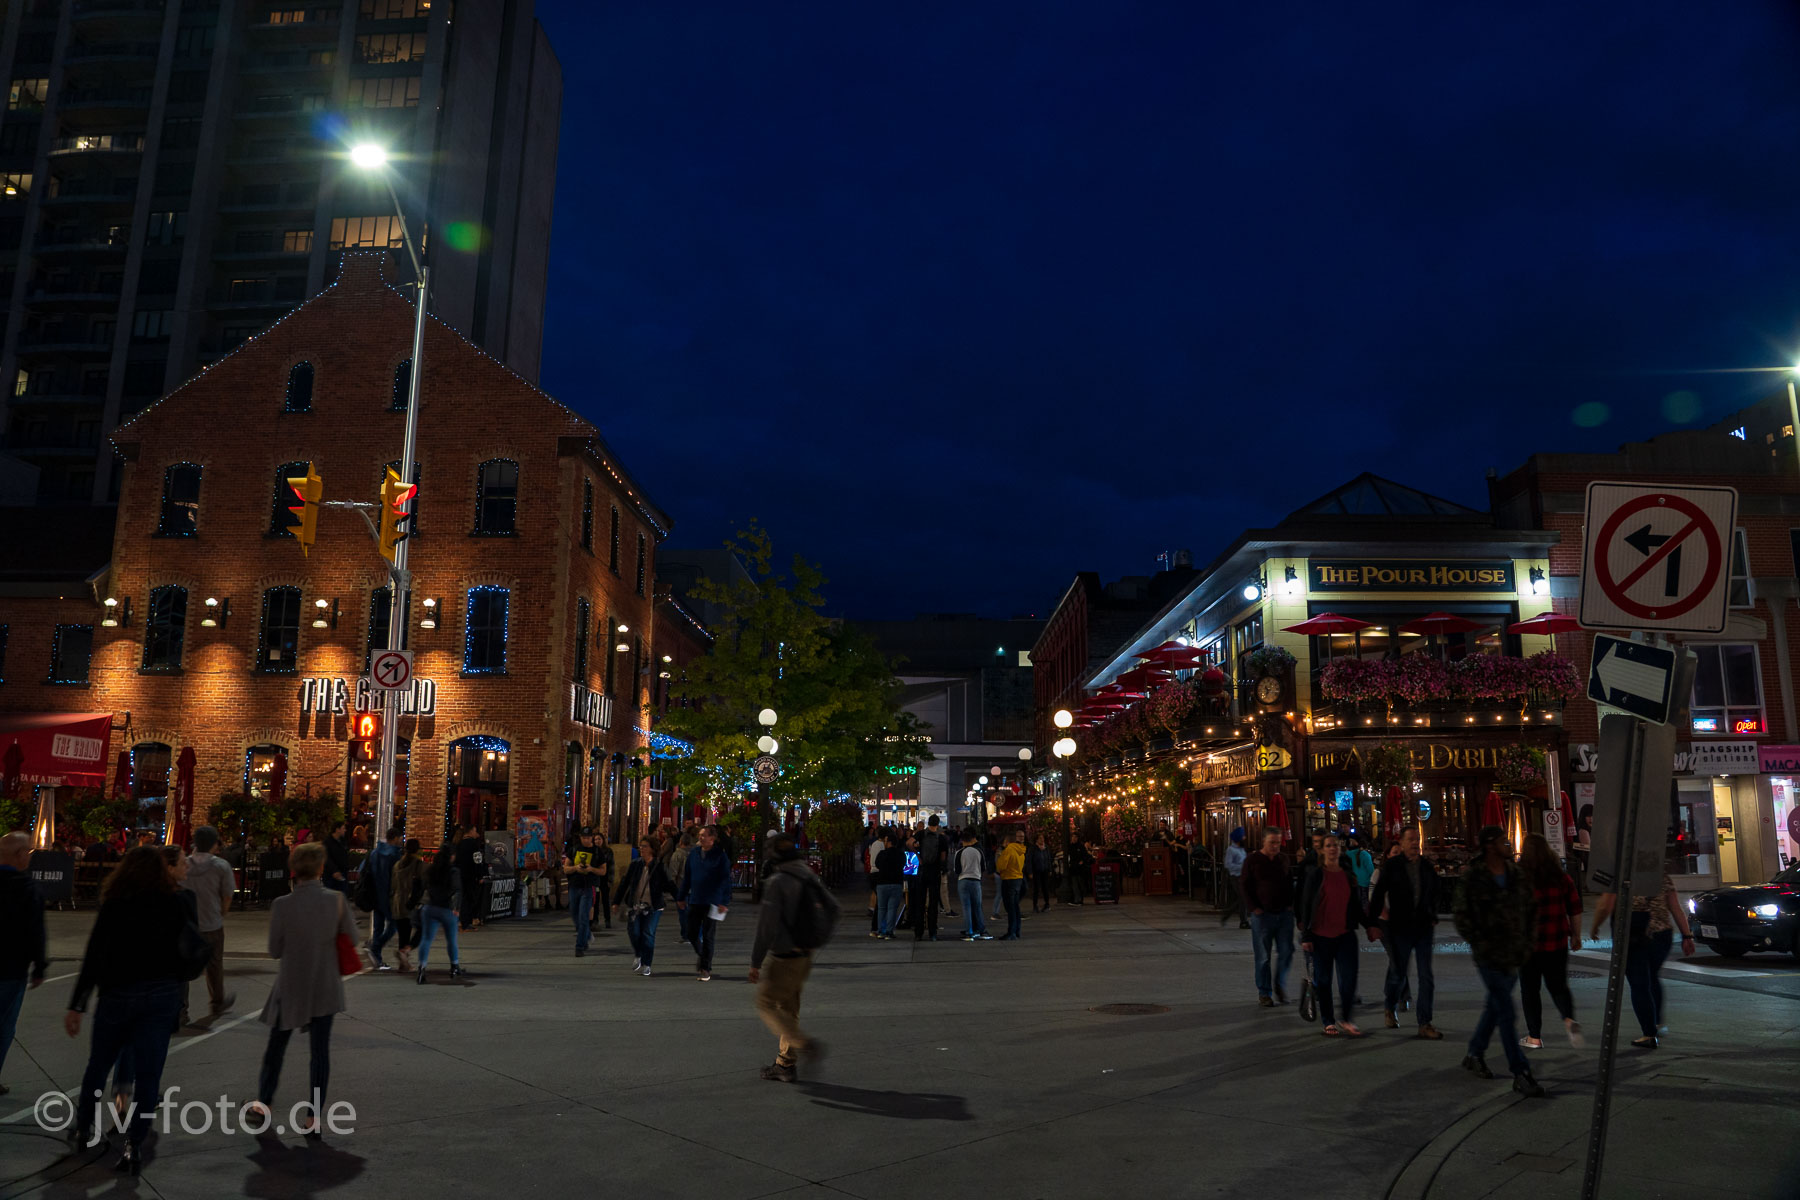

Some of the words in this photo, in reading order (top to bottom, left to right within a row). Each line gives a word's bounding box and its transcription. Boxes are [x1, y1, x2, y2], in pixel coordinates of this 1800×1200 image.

[1316, 565, 1360, 584] THE
[1429, 565, 1507, 585] HOUSE
[302, 677, 348, 713] THE
[354, 677, 437, 715] GRND
[1736, 721, 1757, 732] Open
[54, 736, 72, 756] THE
[73, 739, 101, 759] GRAND
[1695, 745, 1754, 753] FLAGSHIP
[1257, 751, 1282, 768] 62
[1703, 754, 1756, 763] olutions
[40, 775, 46, 783] A
